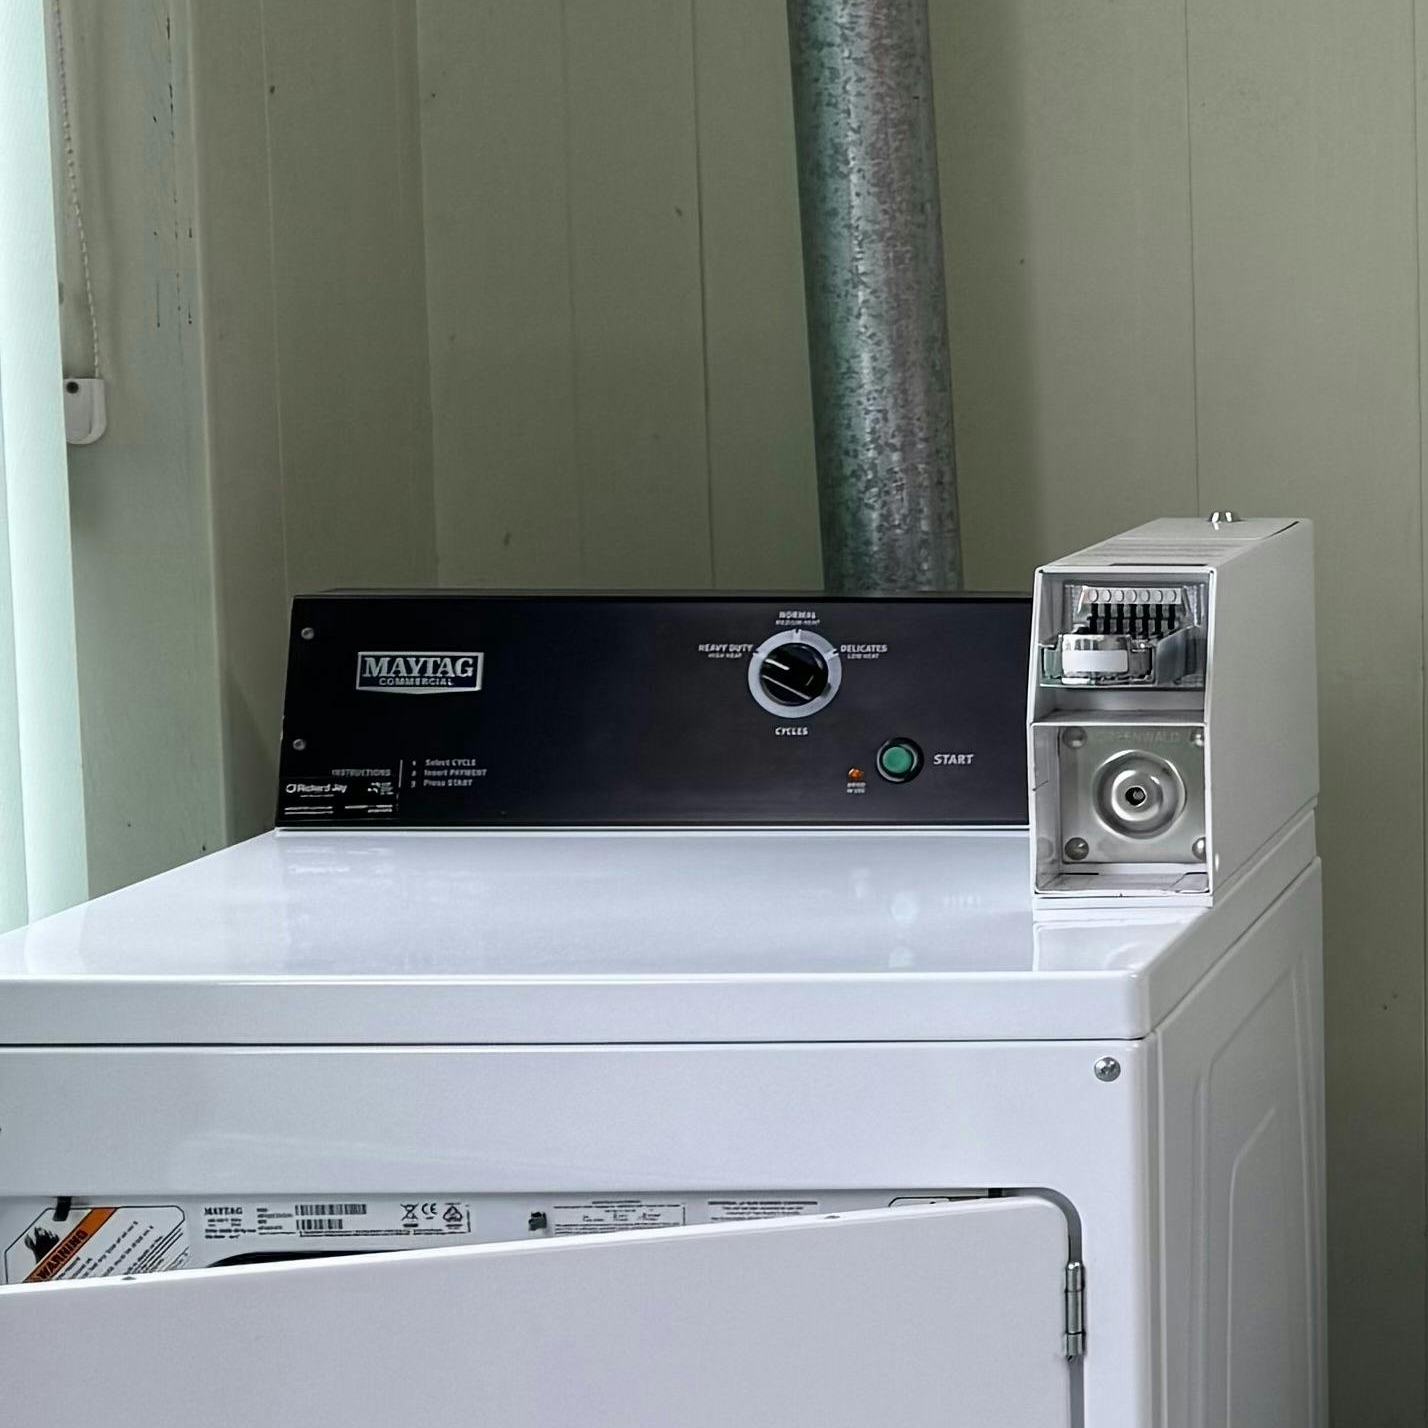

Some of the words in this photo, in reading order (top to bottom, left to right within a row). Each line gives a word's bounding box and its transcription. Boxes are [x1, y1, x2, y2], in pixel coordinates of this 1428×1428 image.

[840, 644, 888, 653] DELICATES
[361, 656, 475, 678] MAYTAG
[378, 677, 455, 686] COMMERCIAL
[933, 753, 975, 765] START
